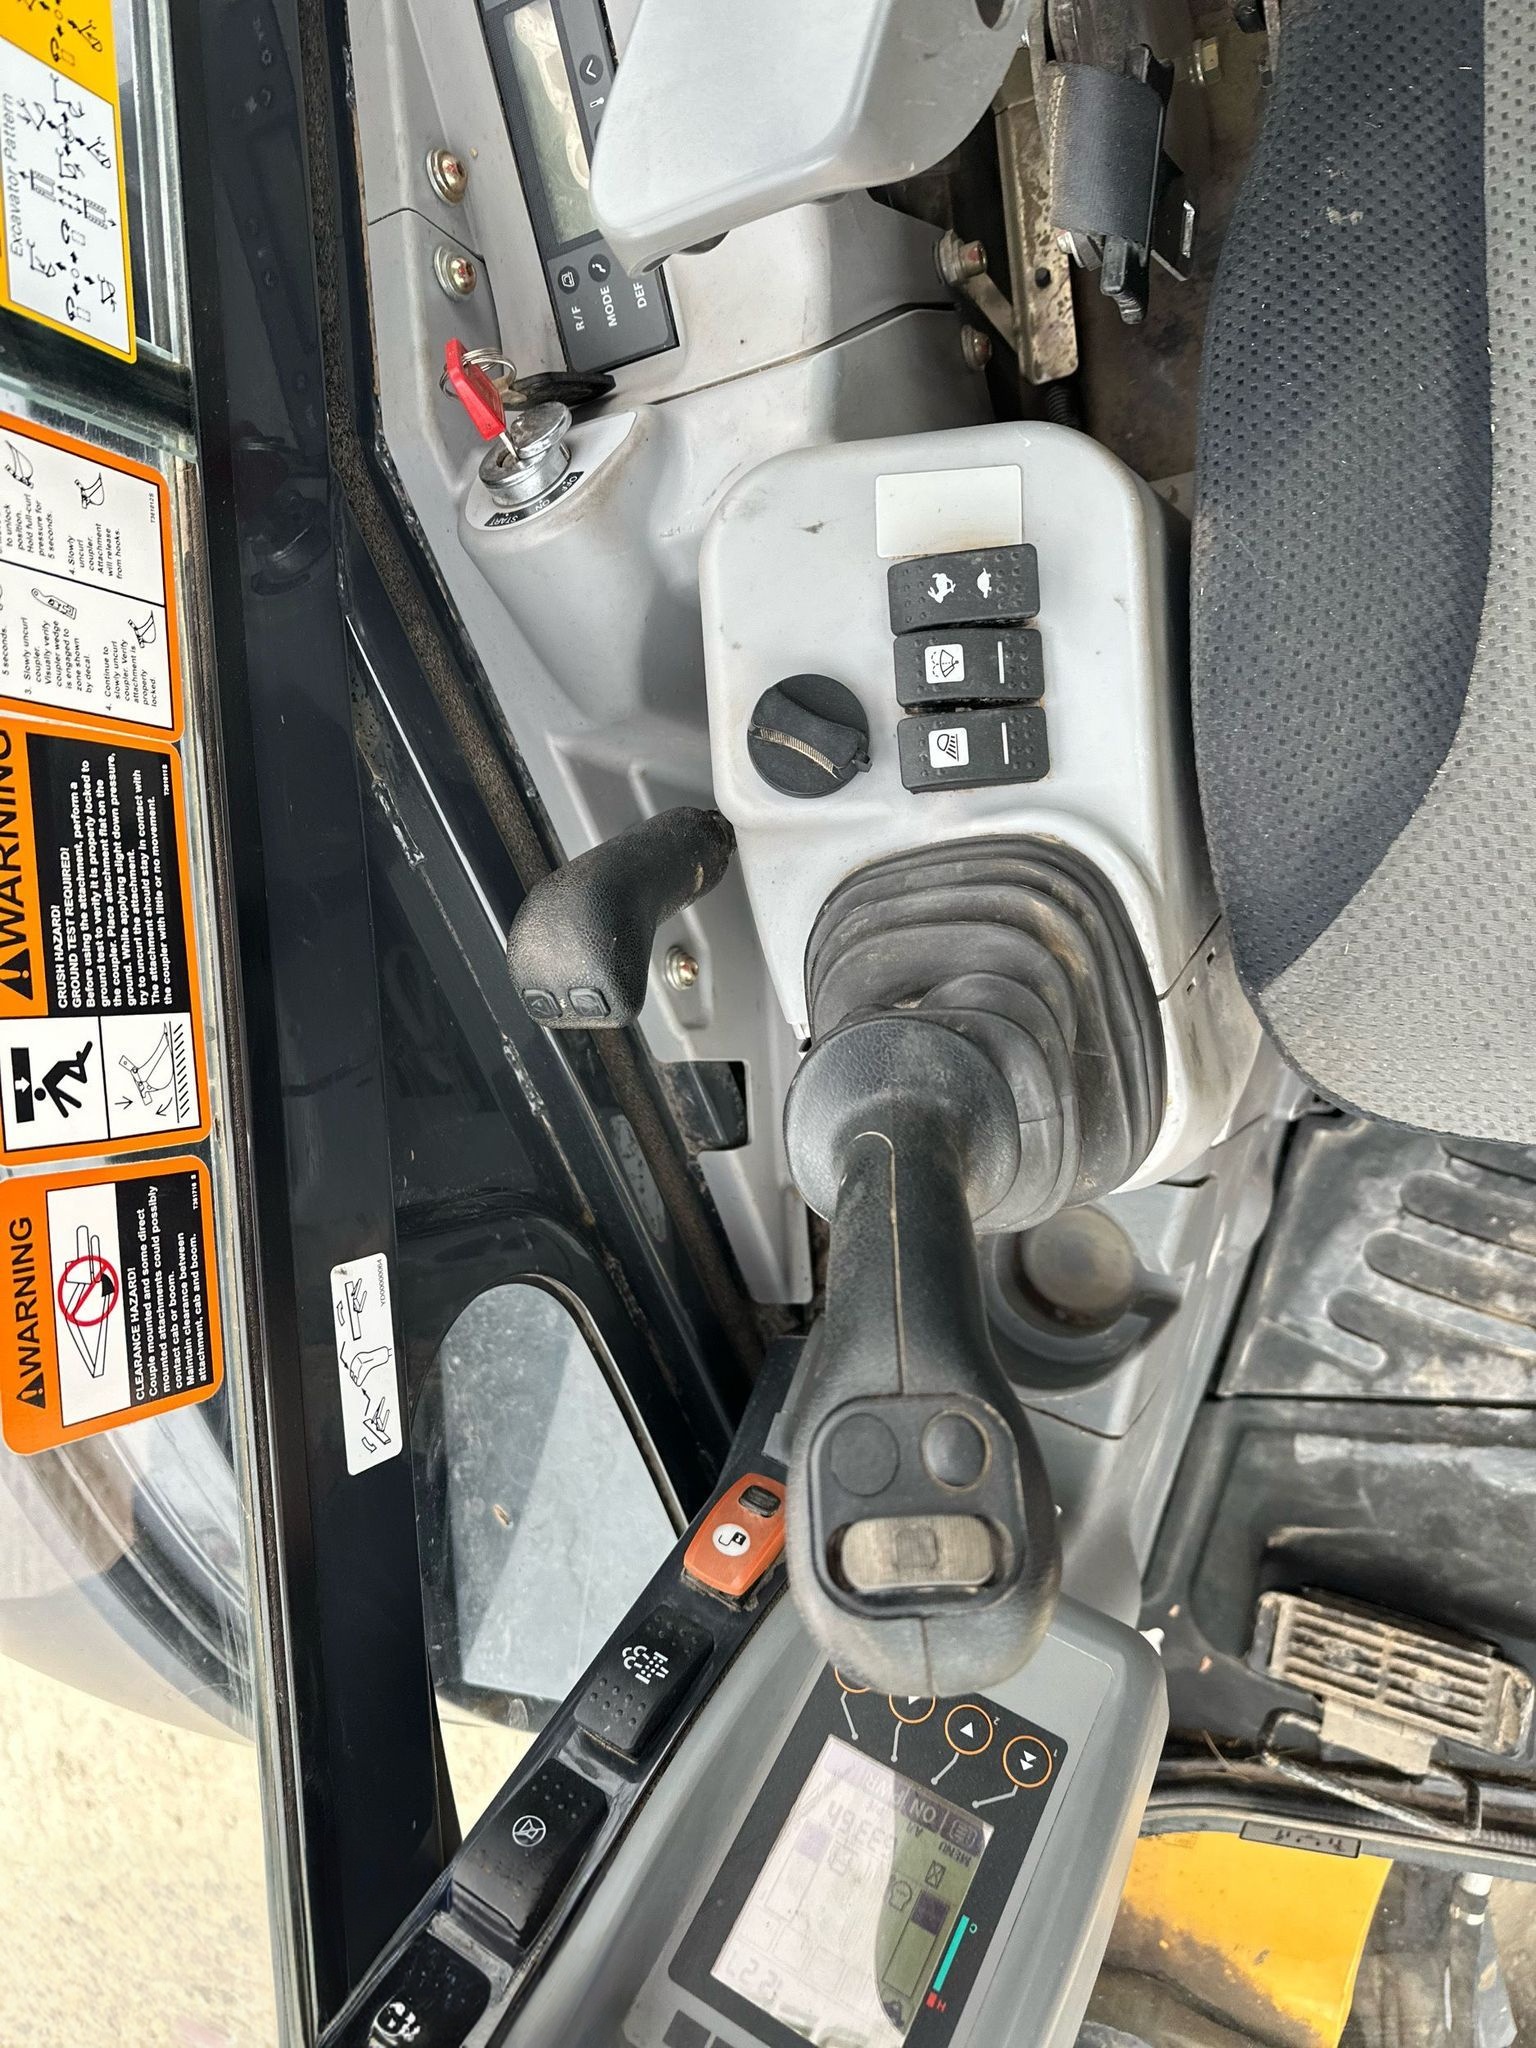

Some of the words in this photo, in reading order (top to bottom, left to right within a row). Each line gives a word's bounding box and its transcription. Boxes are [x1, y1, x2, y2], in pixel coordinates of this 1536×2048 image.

[2, 93, 17, 160] Pattern
[7, 166, 23, 257] Excavator
[600, 285, 618, 327] MODE
[633, 282, 647, 309] DEF
[571, 306, 585, 331] R/F
[3, 504, 12, 535] unlock
[24, 493, 32, 530] full-curl
[35, 500, 43, 514] for
[490, 515, 519, 526] START
[535, 500, 550, 511] ON
[6, 538, 13, 547] to
[15, 511, 25, 550] position.
[26, 532, 34, 553] Hold
[36, 516, 46, 556] pressure
[45, 511, 54, 551] seconds.
[105, 528, 113, 559] release
[67, 536, 75, 565] Slowly
[77, 539, 85, 568] uncurl
[87, 536, 95, 571] coupler.
[95, 523, 104, 574] Attachment
[106, 561, 114, 576] will
[0, 626, 9, 667] seconds.
[20, 617, 29, 647] uncurl
[42, 620, 50, 646] verify
[52, 620, 61, 650] wedge
[63, 628, 70, 637] to
[22, 650, 31, 680] Slowly
[33, 646, 42, 682] coupler.
[63, 640, 73, 679] engaged
[73, 638, 81, 667] shown
[103, 646, 109, 655] to
[111, 641, 120, 669] uncurl
[121, 640, 129, 664] Verify
[130, 645, 136, 653] is
[43, 649, 52, 684] Visually
[54, 652, 63, 687] coupler
[83, 654, 91, 680] decal.
[103, 658, 112, 697] Continue
[131, 655, 140, 703] attachment
[65, 681, 72, 689] is
[85, 682, 93, 693] by
[112, 672, 121, 699] slowly
[123, 668, 132, 701] coupler.
[141, 669, 150, 705] properly
[105, 703, 112, 711] 4.
[80, 760, 90, 773] to
[107, 753, 120, 806] pressure,
[132, 769, 142, 793] with
[70, 782, 78, 790] a
[81, 774, 93, 814] locked
[95, 779, 105, 798] the
[70, 792, 84, 838] perform
[98, 800, 106, 816] on
[111, 808, 121, 839] down
[134, 795, 146, 837] contact
[85, 816, 99, 865] properly
[98, 818, 107, 837] flat
[147, 796, 160, 857] movement.
[113, 842, 124, 874] slight
[138, 839, 147, 850] in
[74, 841, 88, 910] attachment,
[89, 867, 98, 878] is
[99, 839, 113, 904] attachment
[140, 853, 149, 876] stay
[153, 859, 161, 873] no
[60, 847, 74, 916] REQUIRED!
[90, 880, 99, 889] it
[126, 849, 140, 915] attachment.
[141, 878, 152, 917] should
[154, 875, 162, 888] or
[90, 891, 102, 924] verify
[116, 876, 130, 925] applying
[154, 890, 165, 914] little
[51, 905, 64, 961] HAZARD!
[65, 918, 77, 951] TEST
[79, 912, 89, 931] the
[94, 926, 103, 939] to
[107, 906, 116, 937] Place
[133, 917, 142, 935] the
[156, 917, 167, 940] with
[81, 933, 92, 966] using
[95, 940, 105, 963] test
[121, 927, 131, 959] While
[133, 937, 145, 973] uncurl
[145, 919, 158, 982] attachment
[109, 939, 120, 986] coupler.
[160, 942, 171, 985] coupler
[55, 964, 68, 1008] CRUSH
[68, 953, 81, 1008] GROUND
[84, 969, 95, 1008] Before
[97, 965, 111, 1007] ground
[123, 962, 137, 1006] ground.
[137, 976, 146, 988] to
[151, 984, 160, 1005] The
[163, 986, 173, 1005] the
[113, 988, 122, 1007] the
[139, 990, 149, 1006] try
[136, 1208, 147, 1241] direct
[148, 1186, 161, 1233] possibly
[140, 1244, 149, 1276] some
[151, 1235, 161, 1268] could
[177, 1232, 187, 1280] between
[189, 1233, 199, 1269] boom.
[9, 1216, 41, 1378] WARNING
[127, 1267, 140, 1322] HAZARD!
[141, 1278, 151, 1300] and
[168, 1271, 177, 1307] boom.
[191, 1271, 200, 1292] and
[154, 1270, 167, 1340] attachments
[171, 1309, 178, 1321] or
[181, 1282, 191, 1335] clearance
[192, 1294, 202, 1315] cab
[143, 1302, 155, 1353] mounted
[171, 1324, 180, 1344] cab
[131, 1324, 145, 1400] CLEARANCE
[184, 1338, 195, 1386] Maintain
[194, 1317, 207, 1381] attachment,
[147, 1356, 158, 1396] Couple
[159, 1342, 170, 1392] mounted
[172, 1347, 183, 1389] contact
[909, 1799, 936, 1823] ON
[938, 1842, 972, 1868] MENU
[936, 2000, 946, 2013] H
